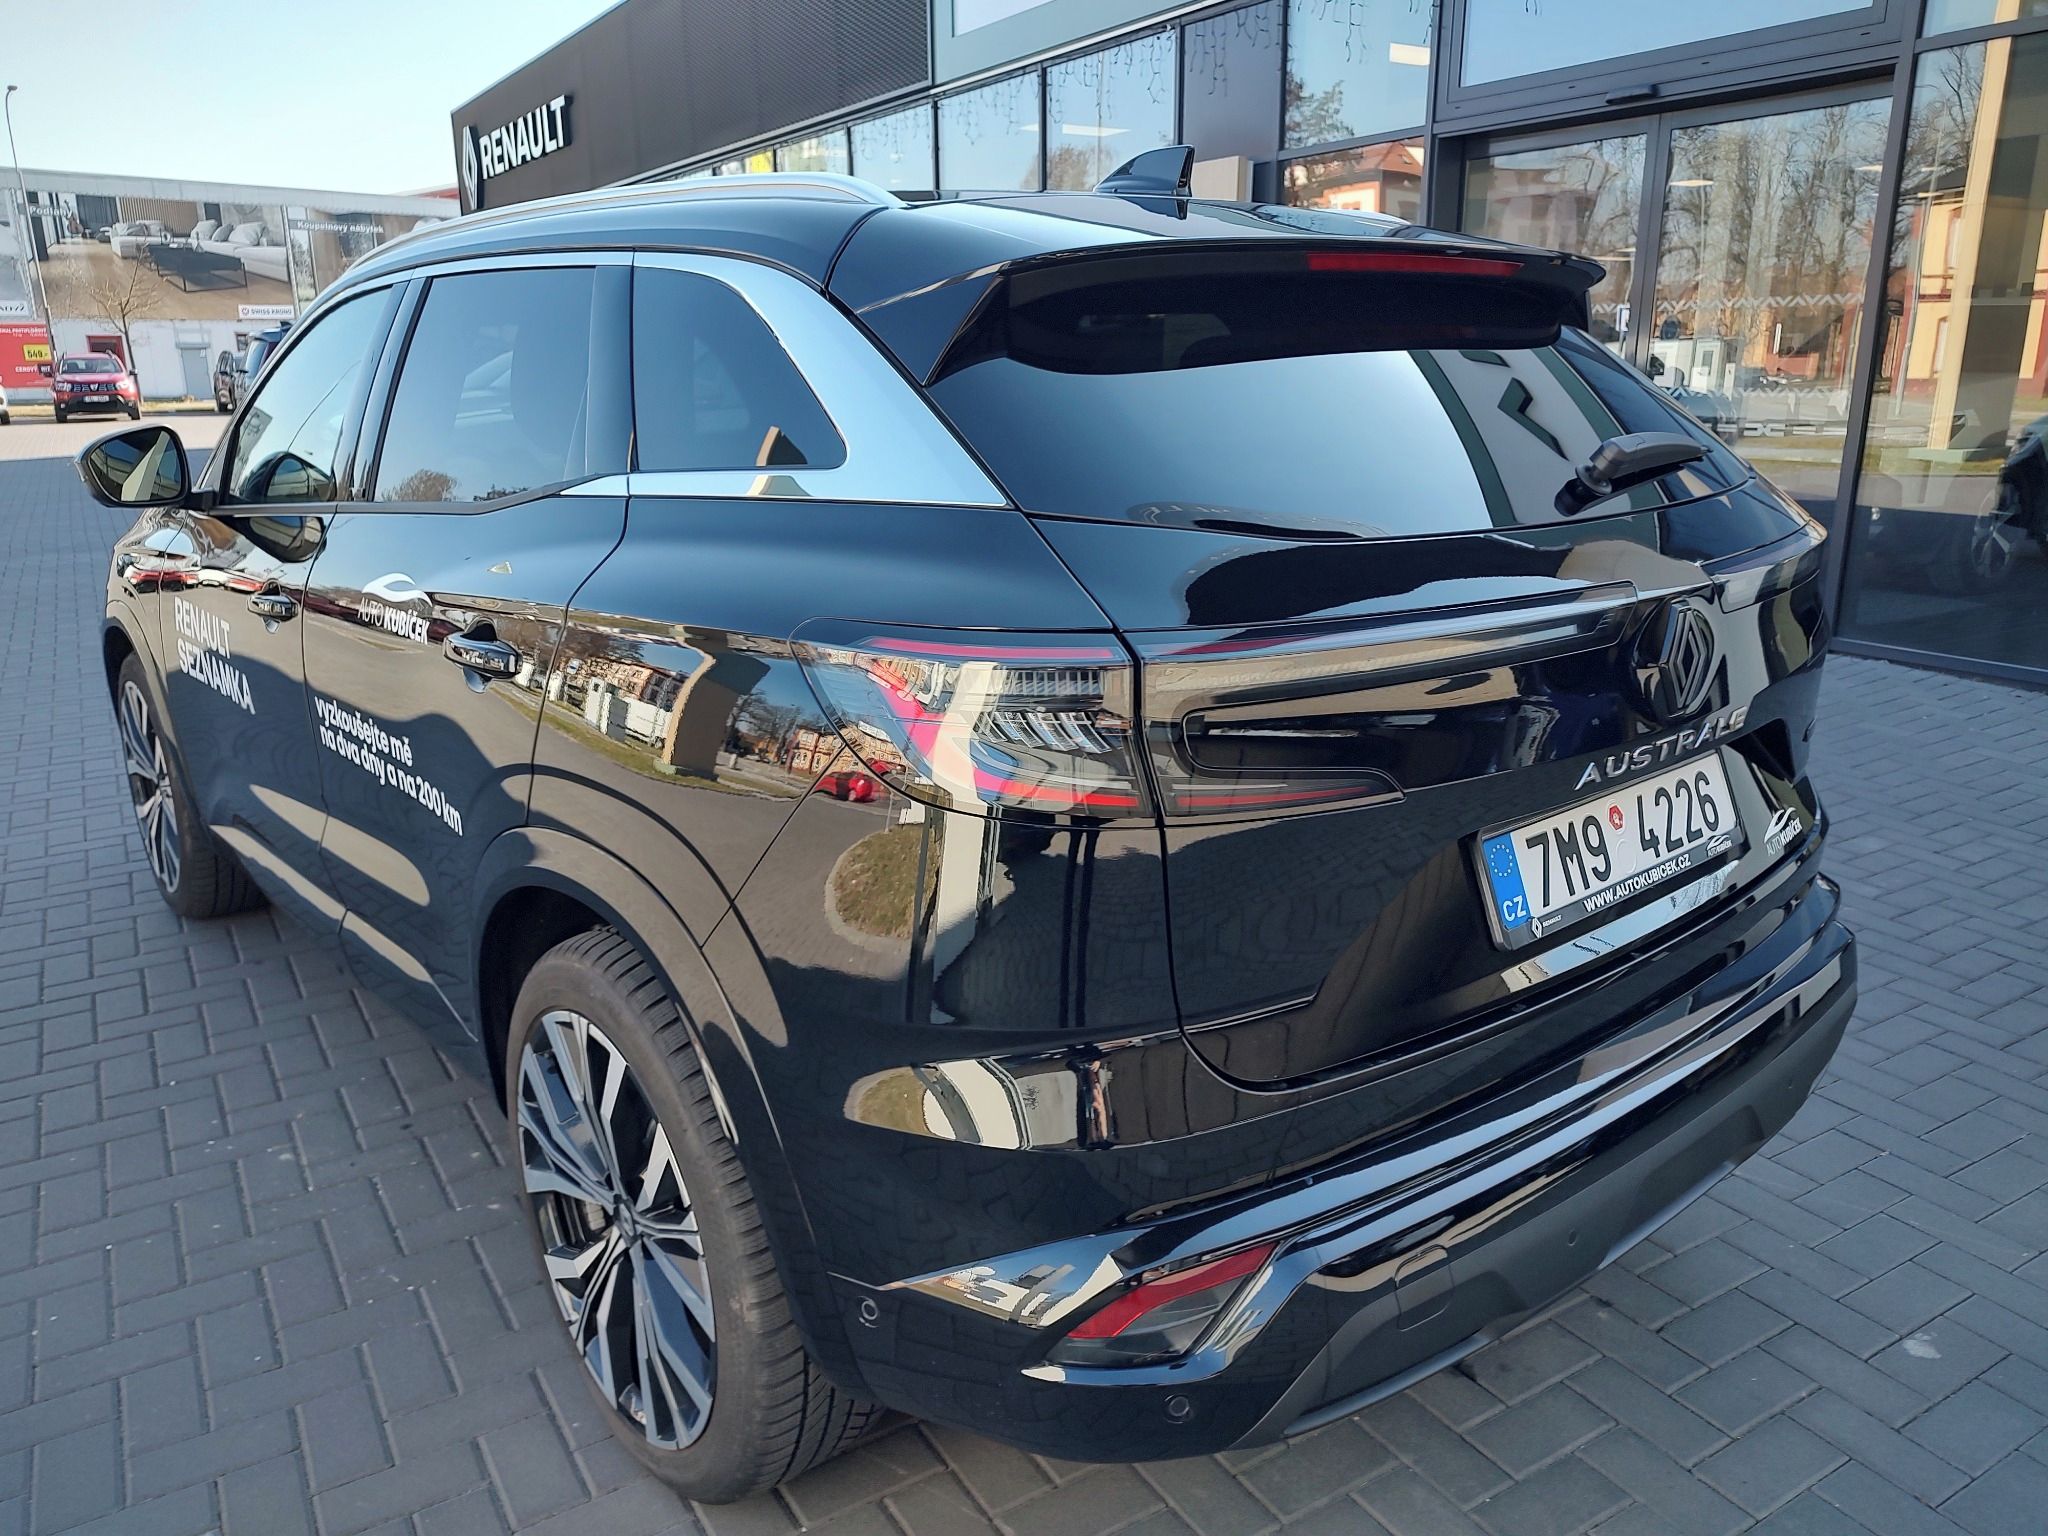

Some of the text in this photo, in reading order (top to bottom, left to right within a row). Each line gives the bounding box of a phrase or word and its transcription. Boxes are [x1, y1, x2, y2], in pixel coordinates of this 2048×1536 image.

[479, 94, 566, 180] RENAULT
[30, 205, 73, 219] Podlahy
[174, 595, 232, 660] RENAULT
[357, 596, 430, 645] AUTO KUBÍČEK
[177, 638, 256, 715] SEZNAMKA
[314, 695, 414, 767] vyzkoušejte mě
[319, 724, 463, 837] na dva dny a na 200 km
[1525, 770, 1720, 909] 7M9 4226
[1502, 895, 1527, 922] CZ
[1583, 853, 1692, 912] WWW.AUTOKUBICEK.CZ
